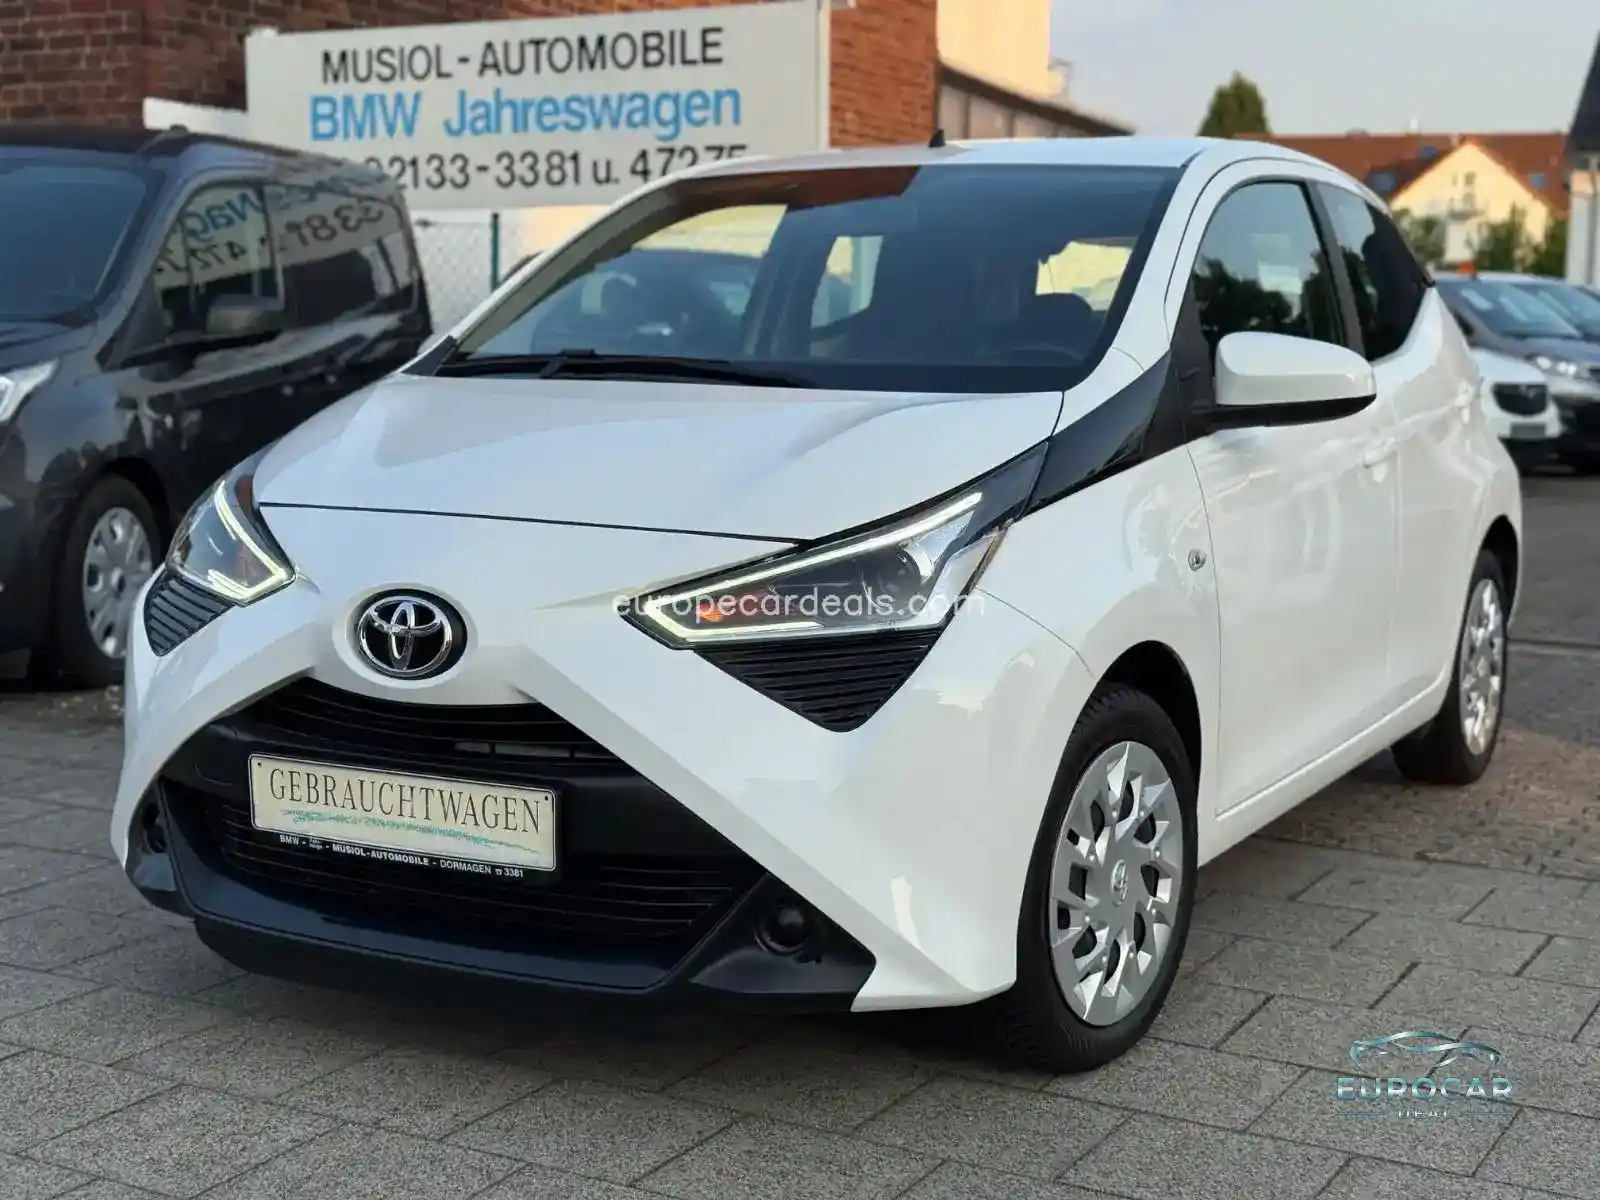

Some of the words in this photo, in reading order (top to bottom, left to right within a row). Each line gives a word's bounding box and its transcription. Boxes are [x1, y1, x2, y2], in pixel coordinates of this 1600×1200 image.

[310, 92, 420, 142] BMW
[443, 87, 742, 142] Jahreswagen
[592, 161, 619, 185] u.
[270, 767, 541, 835] GEBRAUCHTWAGEN
[280, 834, 300, 845] BMW
[440, 860, 493, 875] DORMAGEN
[504, 867, 524, 878] 3381
